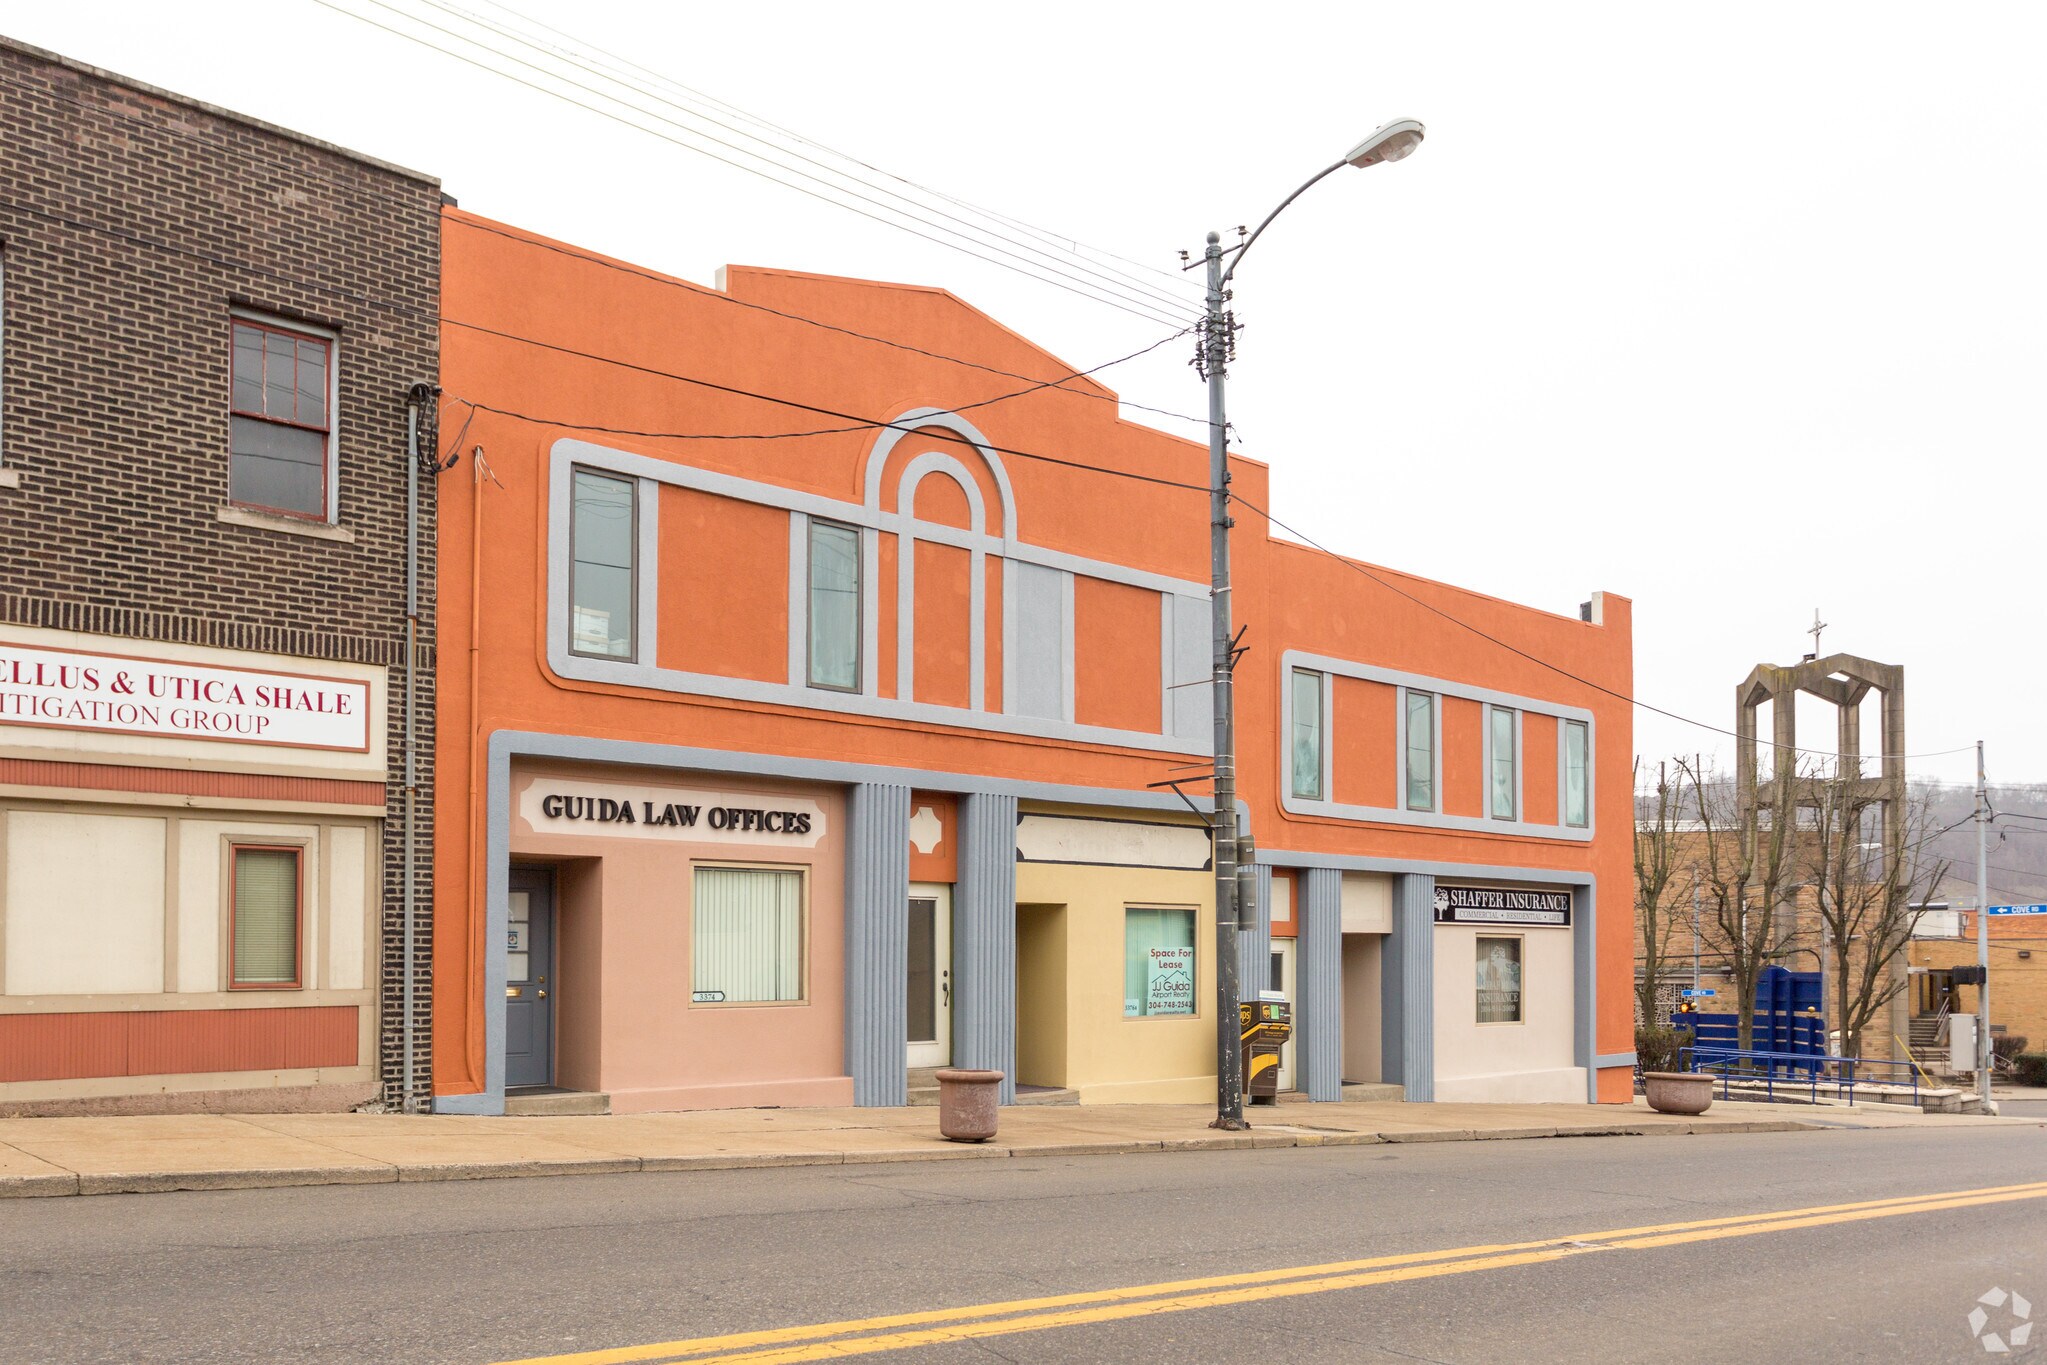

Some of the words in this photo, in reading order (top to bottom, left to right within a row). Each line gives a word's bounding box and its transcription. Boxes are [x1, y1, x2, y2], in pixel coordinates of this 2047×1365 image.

[110, 670, 136, 695] &
[146, 673, 246, 706] UTICA
[255, 685, 352, 716] SHALE
[170, 708, 271, 735] GROUP
[542, 794, 636, 824] GUIDA
[643, 801, 702, 827] LAW
[708, 807, 812, 834] OFFICES
[1450, 889, 1504, 908] SHAFFER
[1505, 893, 1568, 911] INSURANCE
[2011, 906, 2031, 914] COVE
[1459, 910, 1499, 919] COMMERCIAL
[1506, 912, 1542, 921] RESIDENTIAL
[1548, 914, 1561, 922] LIFE
[1150, 948, 1176, 959] Space
[1178, 948, 1192, 958] For
[1158, 960, 1183, 969] Lease
[1152, 982, 1162, 992] JJ
[1163, 981, 1190, 992] Guida
[1151, 991, 1173, 999] Airport
[1173, 991, 1190, 999] Realty
[1149, 1000, 1193, 1009] 304-748-2543
